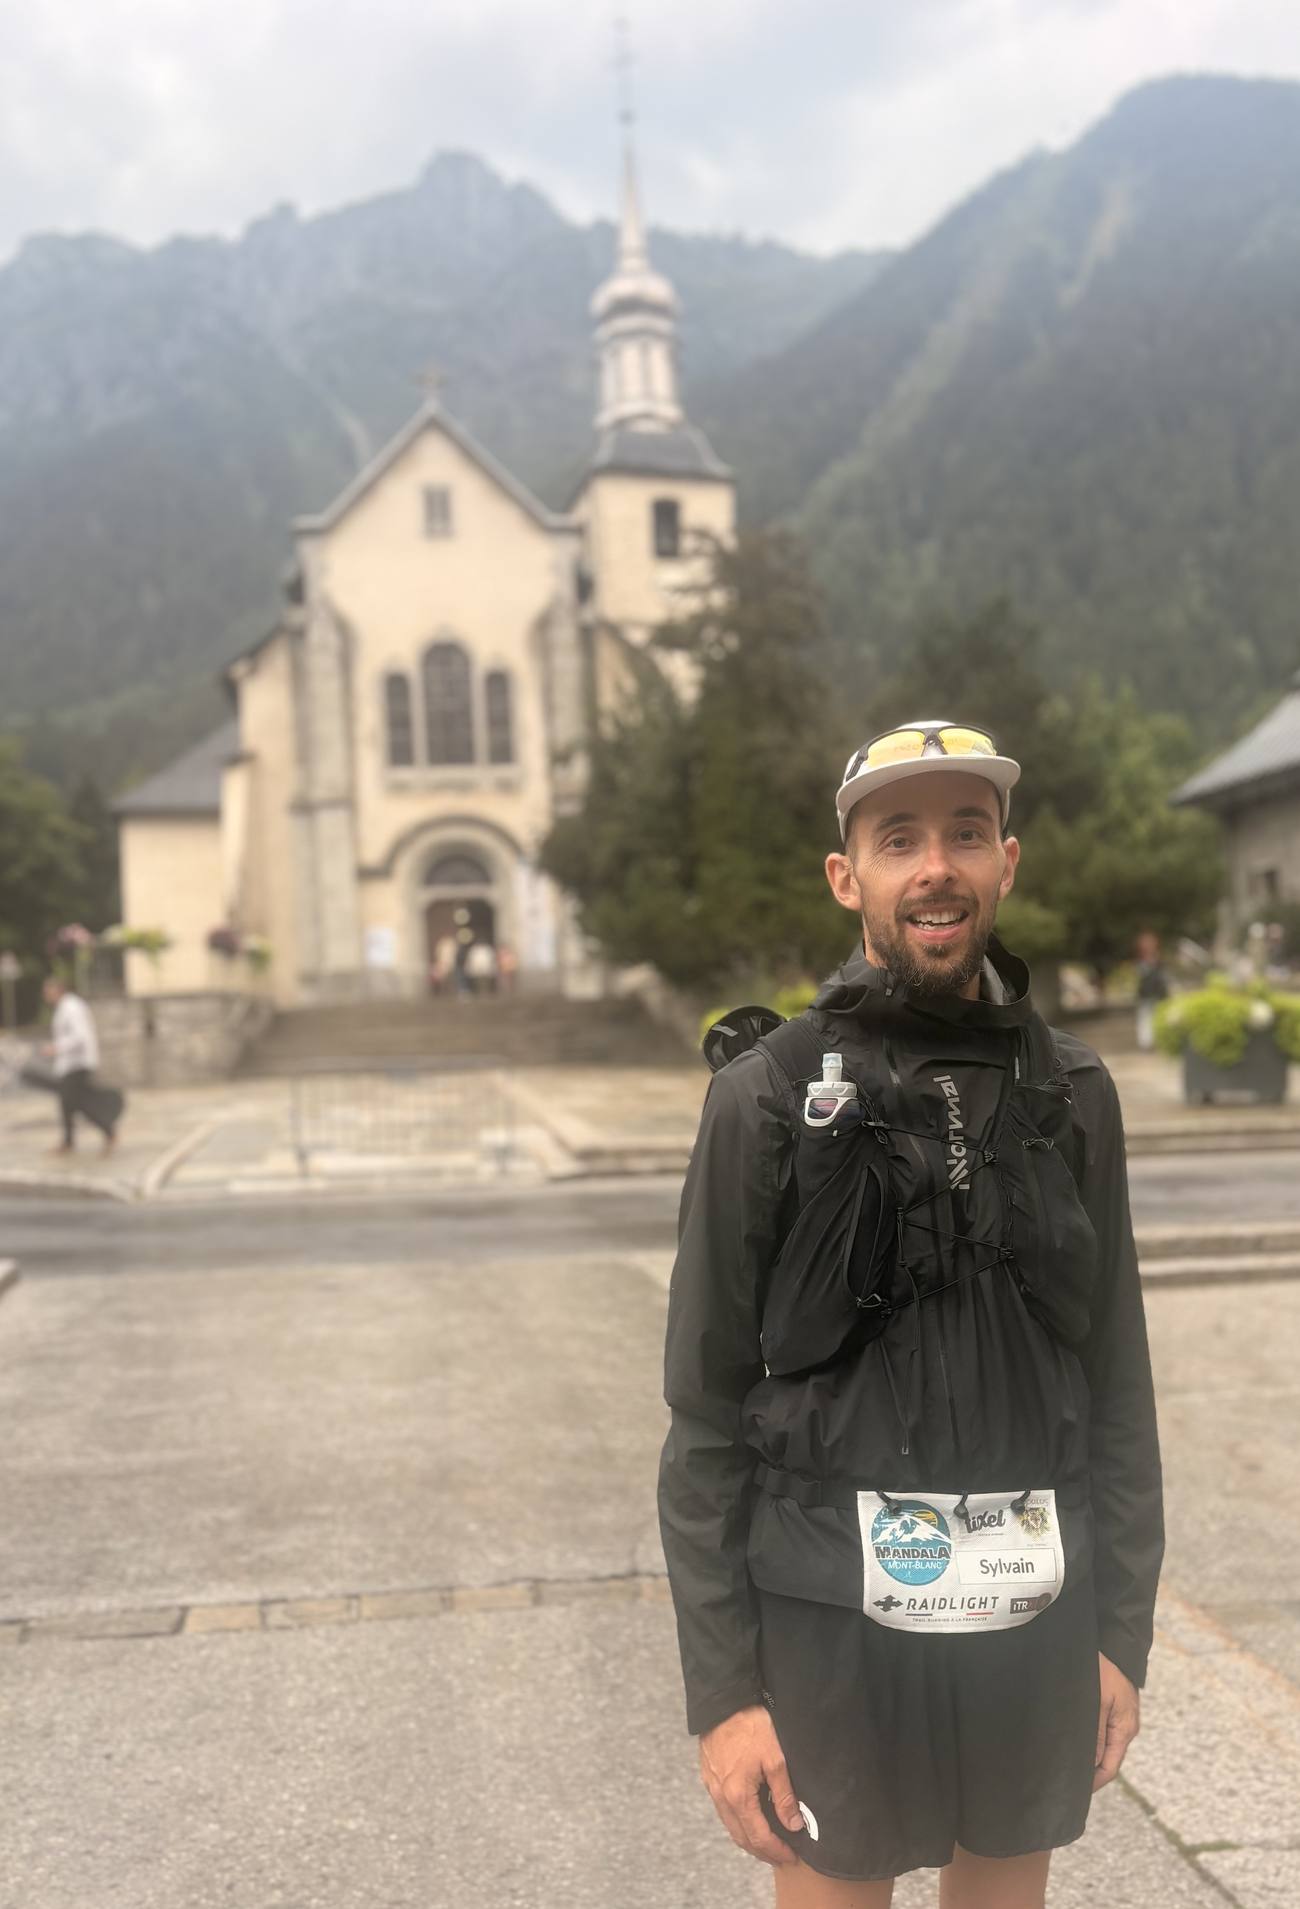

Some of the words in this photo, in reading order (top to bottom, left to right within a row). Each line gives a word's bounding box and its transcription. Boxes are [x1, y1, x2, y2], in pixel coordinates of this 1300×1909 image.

[874, 1545, 951, 1559] MANDALA
[887, 1560, 942, 1570] MONT-BLANC
[979, 1557, 1035, 1578] Sylvain
[906, 1596, 1000, 1610] RAIDLIGHT
